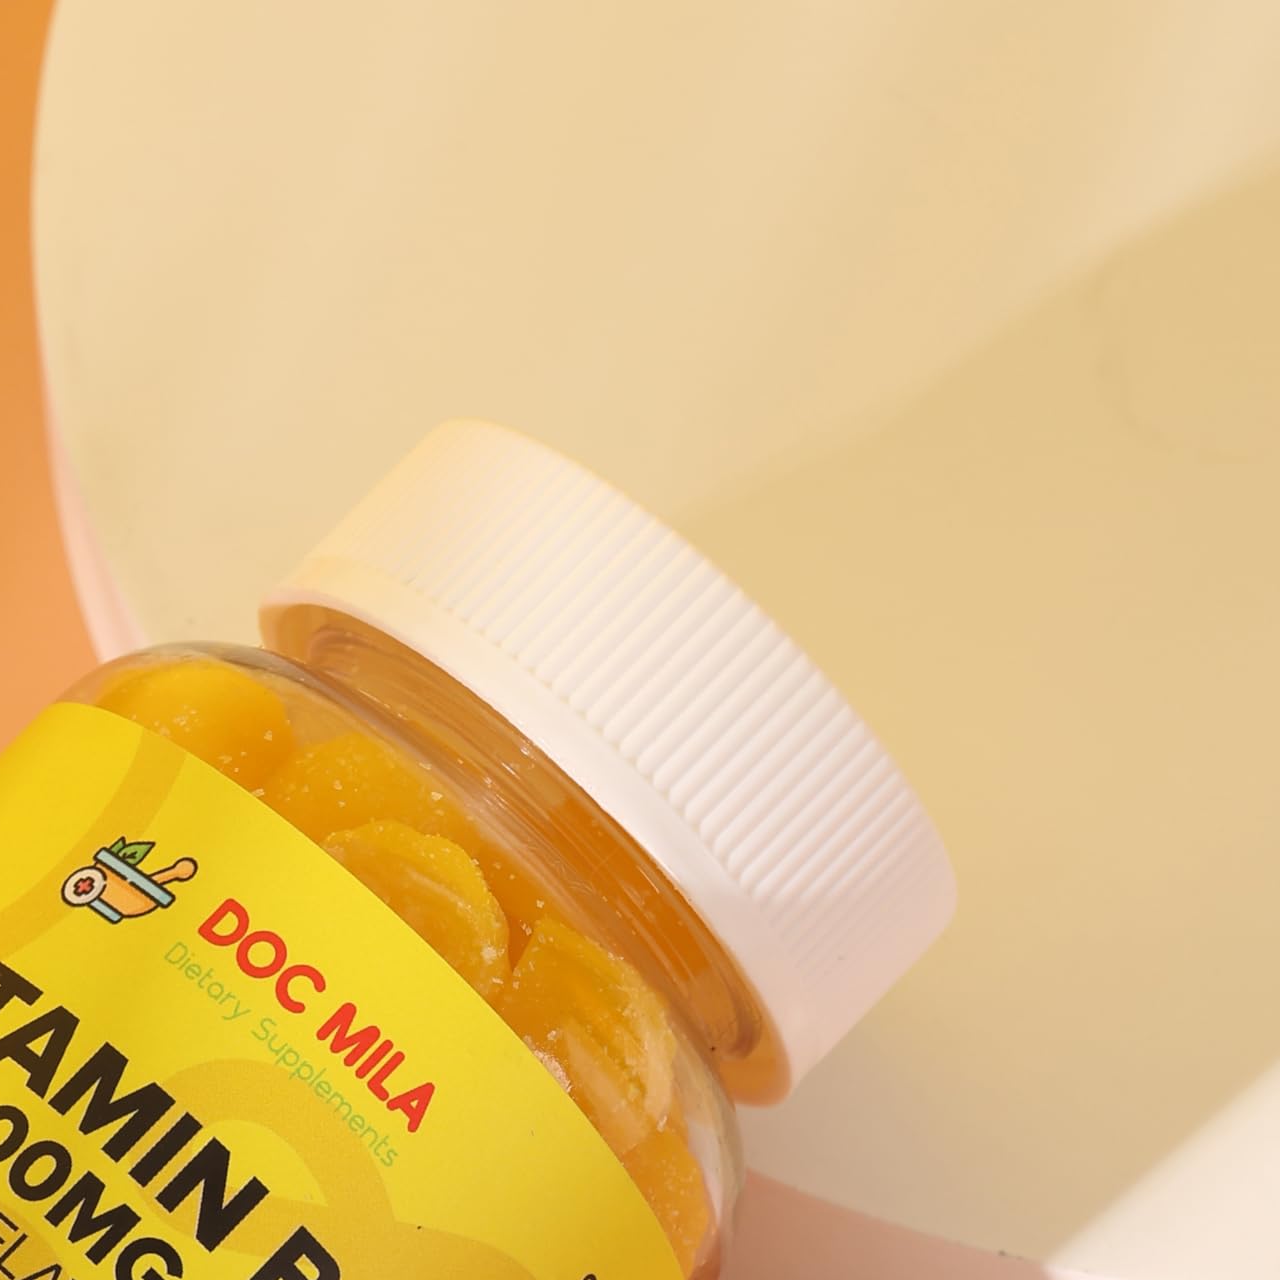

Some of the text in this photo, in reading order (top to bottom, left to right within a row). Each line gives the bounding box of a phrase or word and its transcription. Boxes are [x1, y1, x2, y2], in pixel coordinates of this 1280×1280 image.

[164, 941, 399, 1168] Dietary Supplements
[198, 898, 436, 1133] DOC MILA
